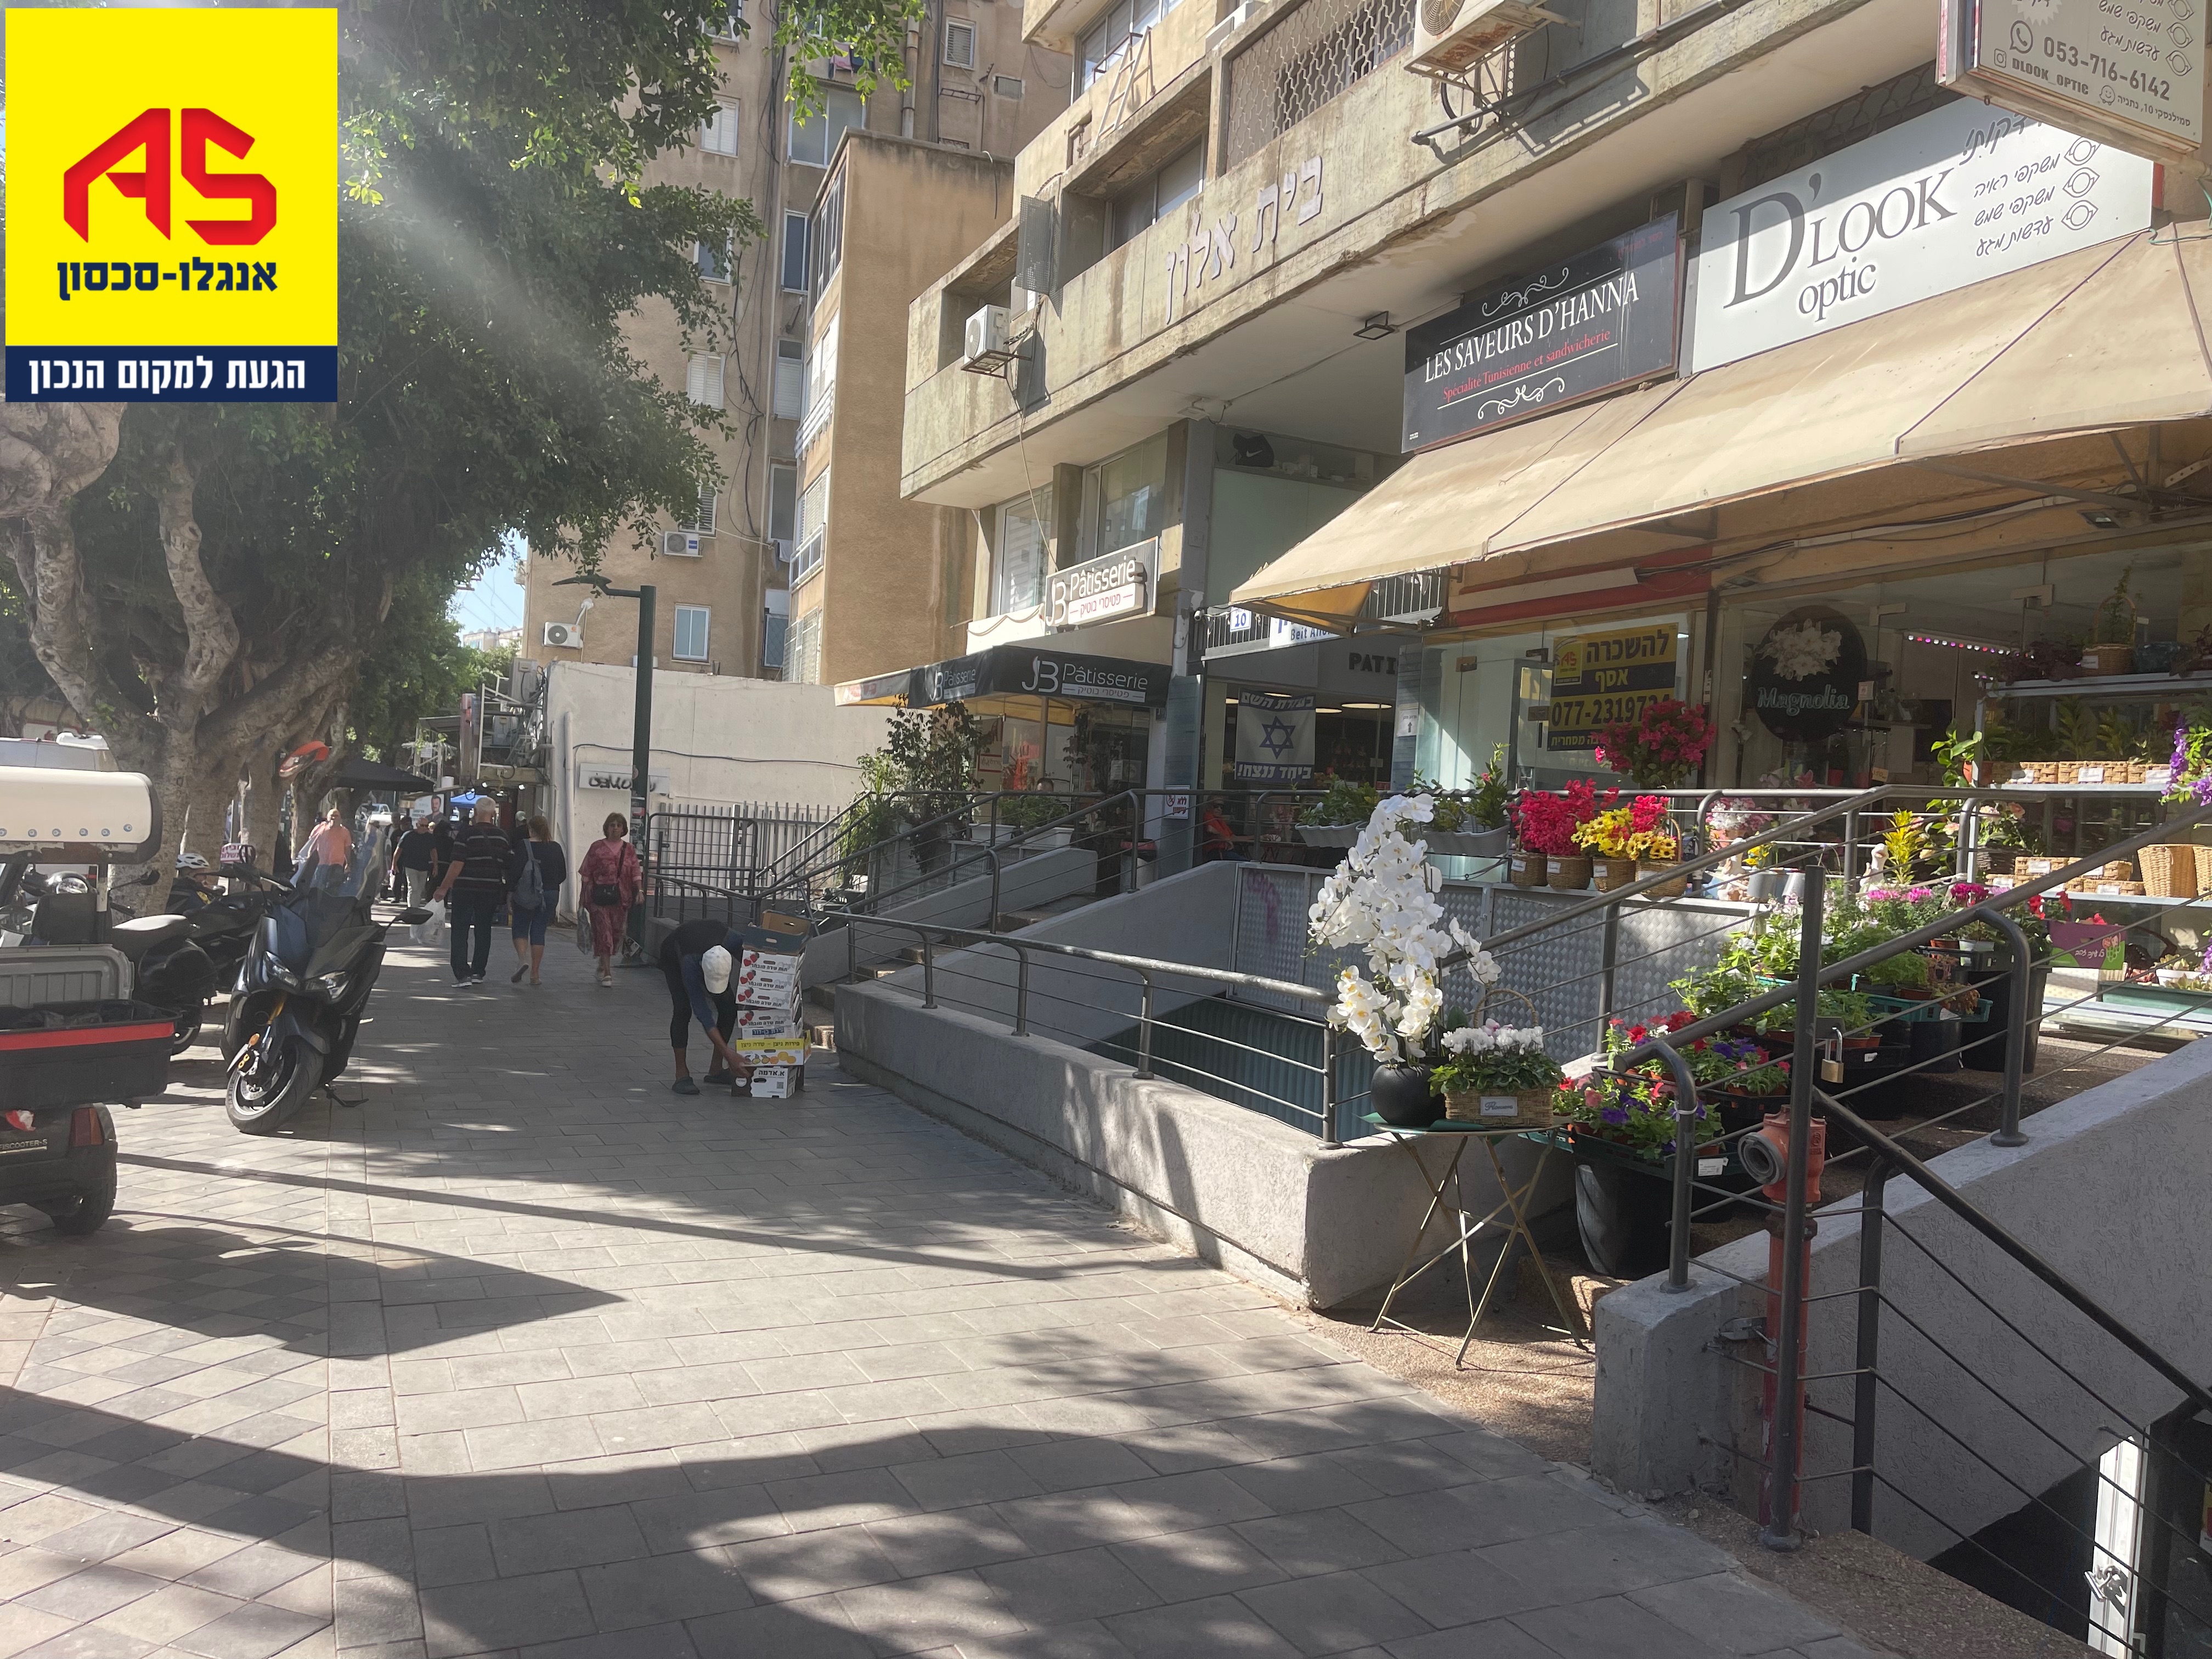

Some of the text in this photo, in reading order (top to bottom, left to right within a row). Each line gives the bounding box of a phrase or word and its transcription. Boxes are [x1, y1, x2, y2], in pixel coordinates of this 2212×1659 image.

[2098, 0, 2161, 33] משקפי שמש
[2101, 26, 2160, 61] עדשות מגע
[2012, 58, 2089, 95] DLOOK_OPTIC
[2044, 37, 2170, 101] 053-716-6142
[2118, 95, 2138, 109] נתניה
[2155, 109, 2190, 127] סמילנסקי
[1974, 154, 2060, 198] משקפי ראיה
[1974, 186, 2055, 226] משקפי שמש
[1165, 155, 1323, 325] בית אלון
[1723, 168, 1957, 309] D'LOOK
[1976, 216, 2053, 257] עדשות מגע
[1798, 256, 1876, 322] optic
[1425, 348, 1451, 383] LES
[1455, 314, 1534, 371] SAVEURS
[1443, 330, 1611, 403] Spécialité Tunisienne et sandwicherie
[1046, 555, 1136, 626] JB Pâtisserie
[1080, 594, 1121, 618] פטיסרי בוטיק
[1234, 612, 1246, 627] 10
[1291, 627, 1307, 641] Beit
[1587, 629, 1669, 663] להשכרה
[944, 669, 976, 687] Pâtsserie
[1022, 656, 1148, 693] JB Pâtisserie
[1349, 652, 1398, 675] PATI
[1077, 686, 1130, 698] פטיסרי בוטיק
[1595, 668, 1628, 693] אסף
[1240, 692, 1314, 709] בעזרת השם
[1757, 684, 1850, 716] Magnolia
[1551, 736, 1585, 746] מסחרית
[1237, 764, 1312, 779] ביחד ננצח!
